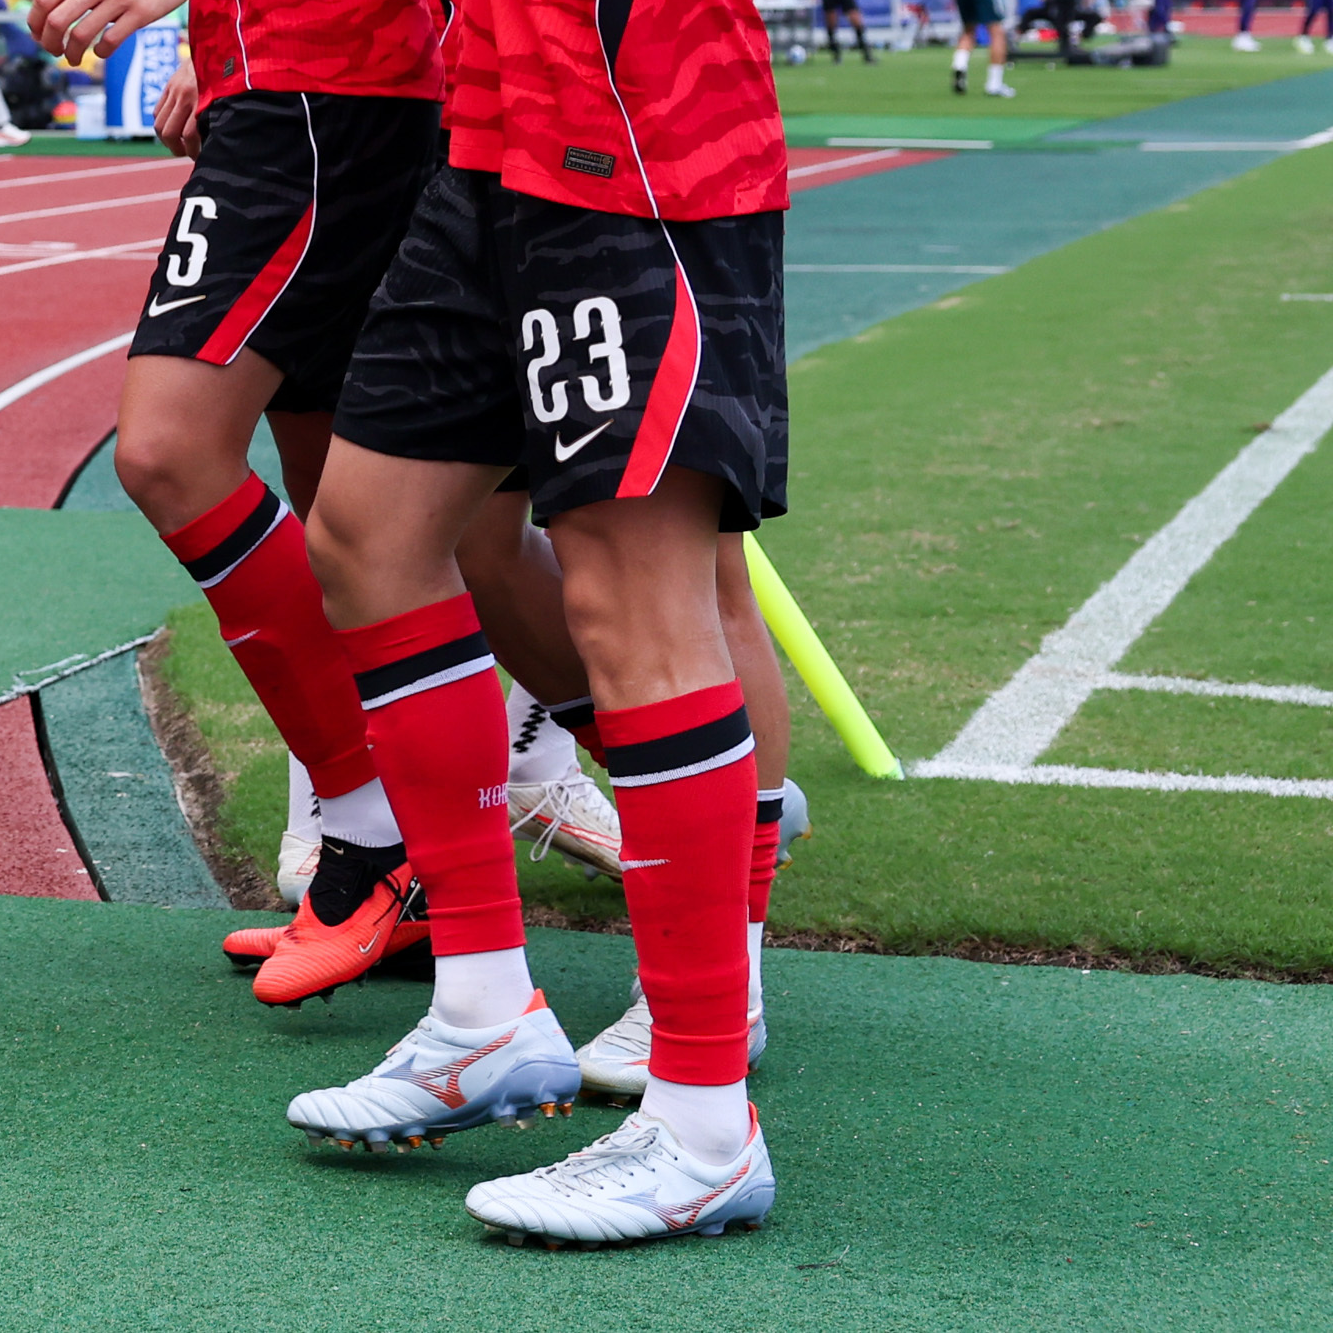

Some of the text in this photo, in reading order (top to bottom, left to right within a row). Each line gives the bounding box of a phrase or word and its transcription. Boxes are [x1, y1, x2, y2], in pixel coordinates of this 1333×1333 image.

[166, 196, 218, 288] 5
[521, 296, 631, 423] 23
[478, 782, 509, 809] KOR
